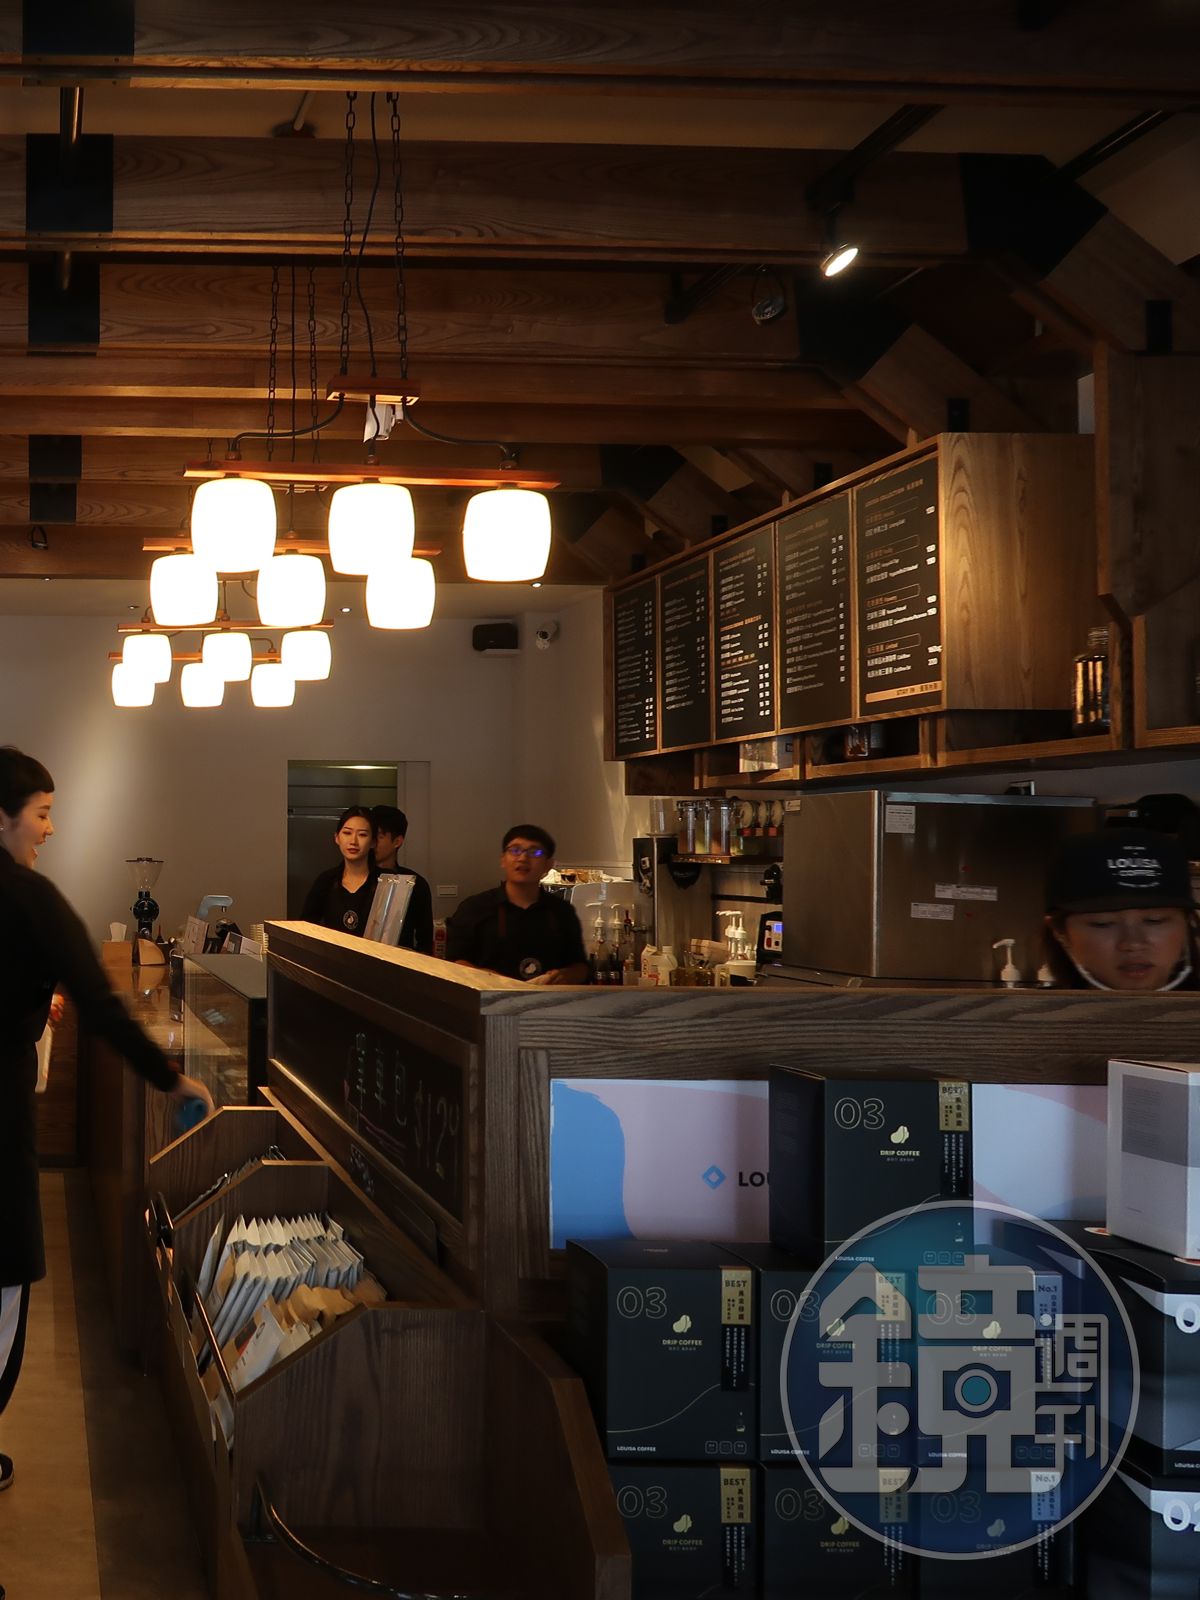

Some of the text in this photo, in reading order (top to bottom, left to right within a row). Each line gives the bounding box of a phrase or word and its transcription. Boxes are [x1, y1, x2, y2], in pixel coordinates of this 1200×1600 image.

[1106, 857, 1162, 870] LOUISA
[833, 1096, 886, 1130] 03
[879, 1149, 921, 1157] DRIP COFFEE
[738, 1171, 770, 1187] LO
[724, 1279, 748, 1288] BEST
[1037, 1284, 1058, 1293] No.1
[616, 1285, 668, 1320] 03
[770, 1288, 820, 1323] 03
[925, 1291, 977, 1326] 03
[662, 1338, 703, 1346] DRIP COFFEE
[815, 1342, 856, 1350] DRIP COFFEE
[723, 1478, 746, 1486] BEST
[1035, 1474, 1056, 1483] No.1
[616, 1485, 668, 1519] 03
[774, 1487, 825, 1521] 03
[930, 1490, 982, 1523] 03
[662, 1538, 704, 1546] DRIP COFFEE
